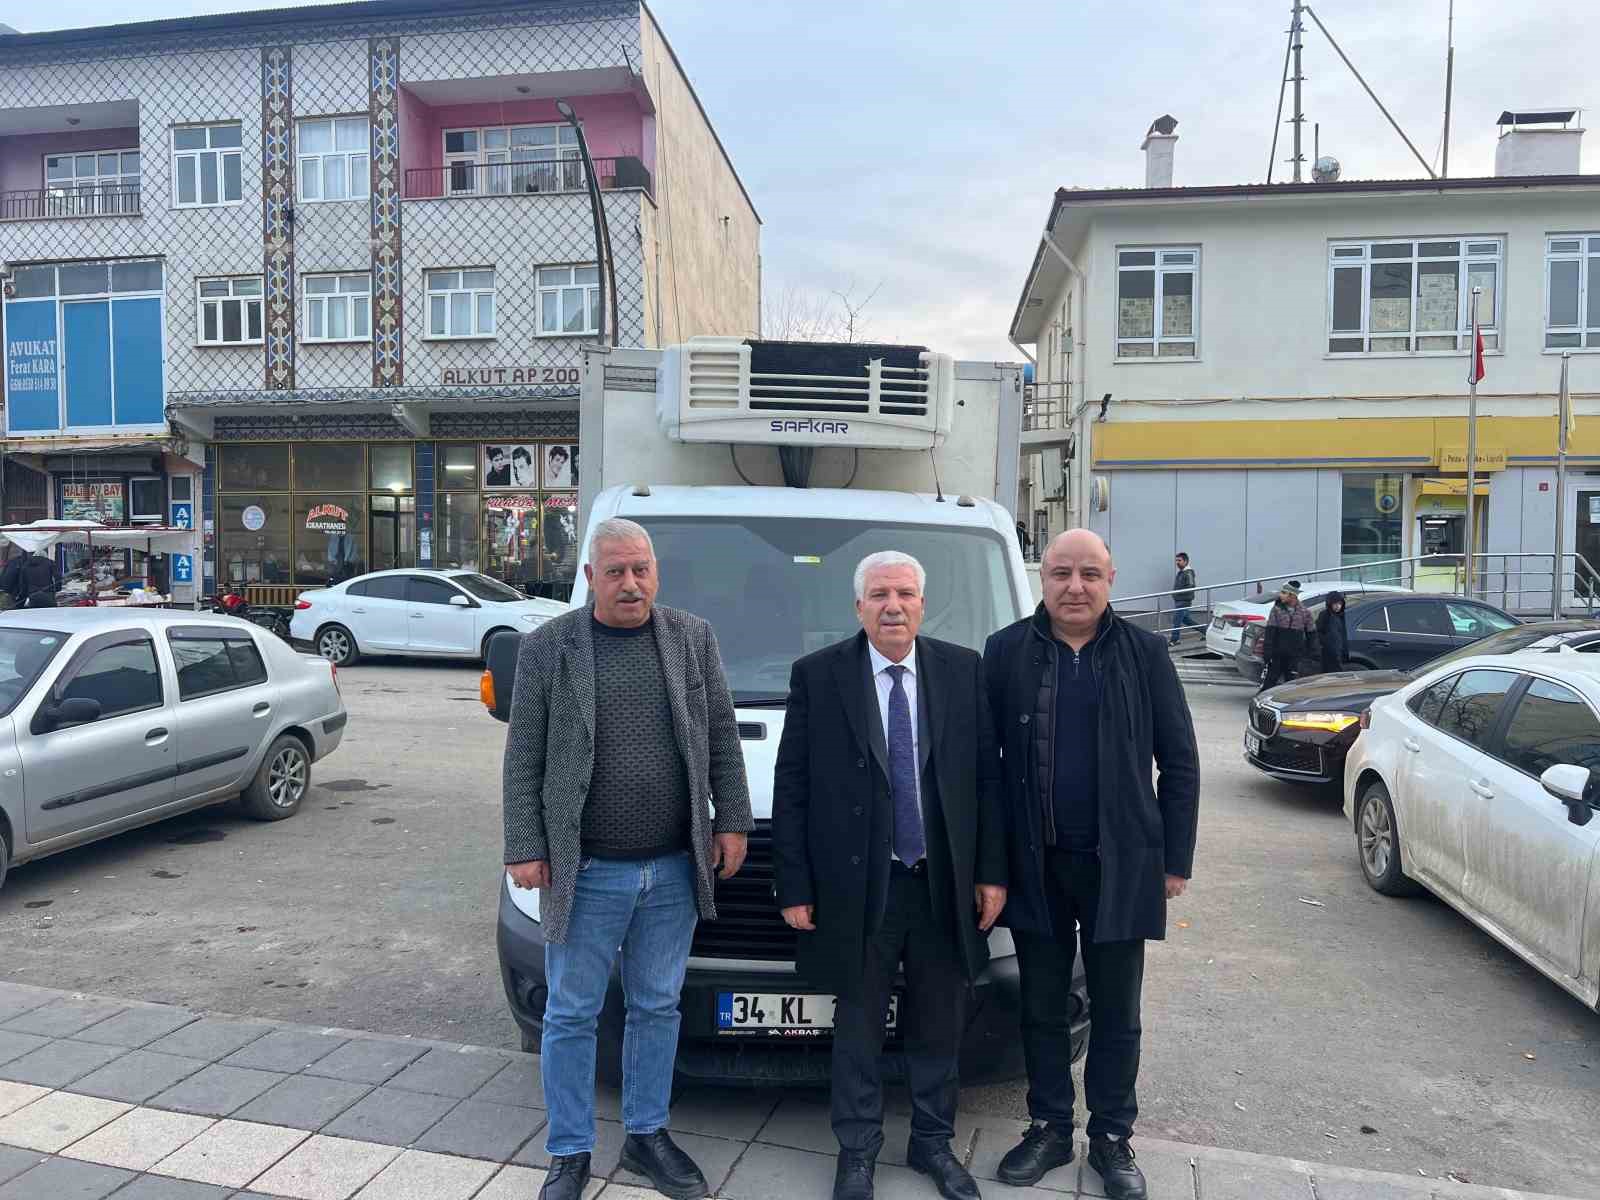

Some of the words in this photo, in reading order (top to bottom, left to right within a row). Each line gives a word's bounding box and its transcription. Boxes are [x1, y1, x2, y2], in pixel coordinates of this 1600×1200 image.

[9, 340, 56, 356] AVUKAT
[32, 358, 55, 374] KARA
[512, 368, 537, 383] AP
[770, 420, 849, 434] SAFKAR
[719, 1011, 732, 1021] TR
[733, 996, 766, 1024] 34
[780, 996, 812, 1024] KL
